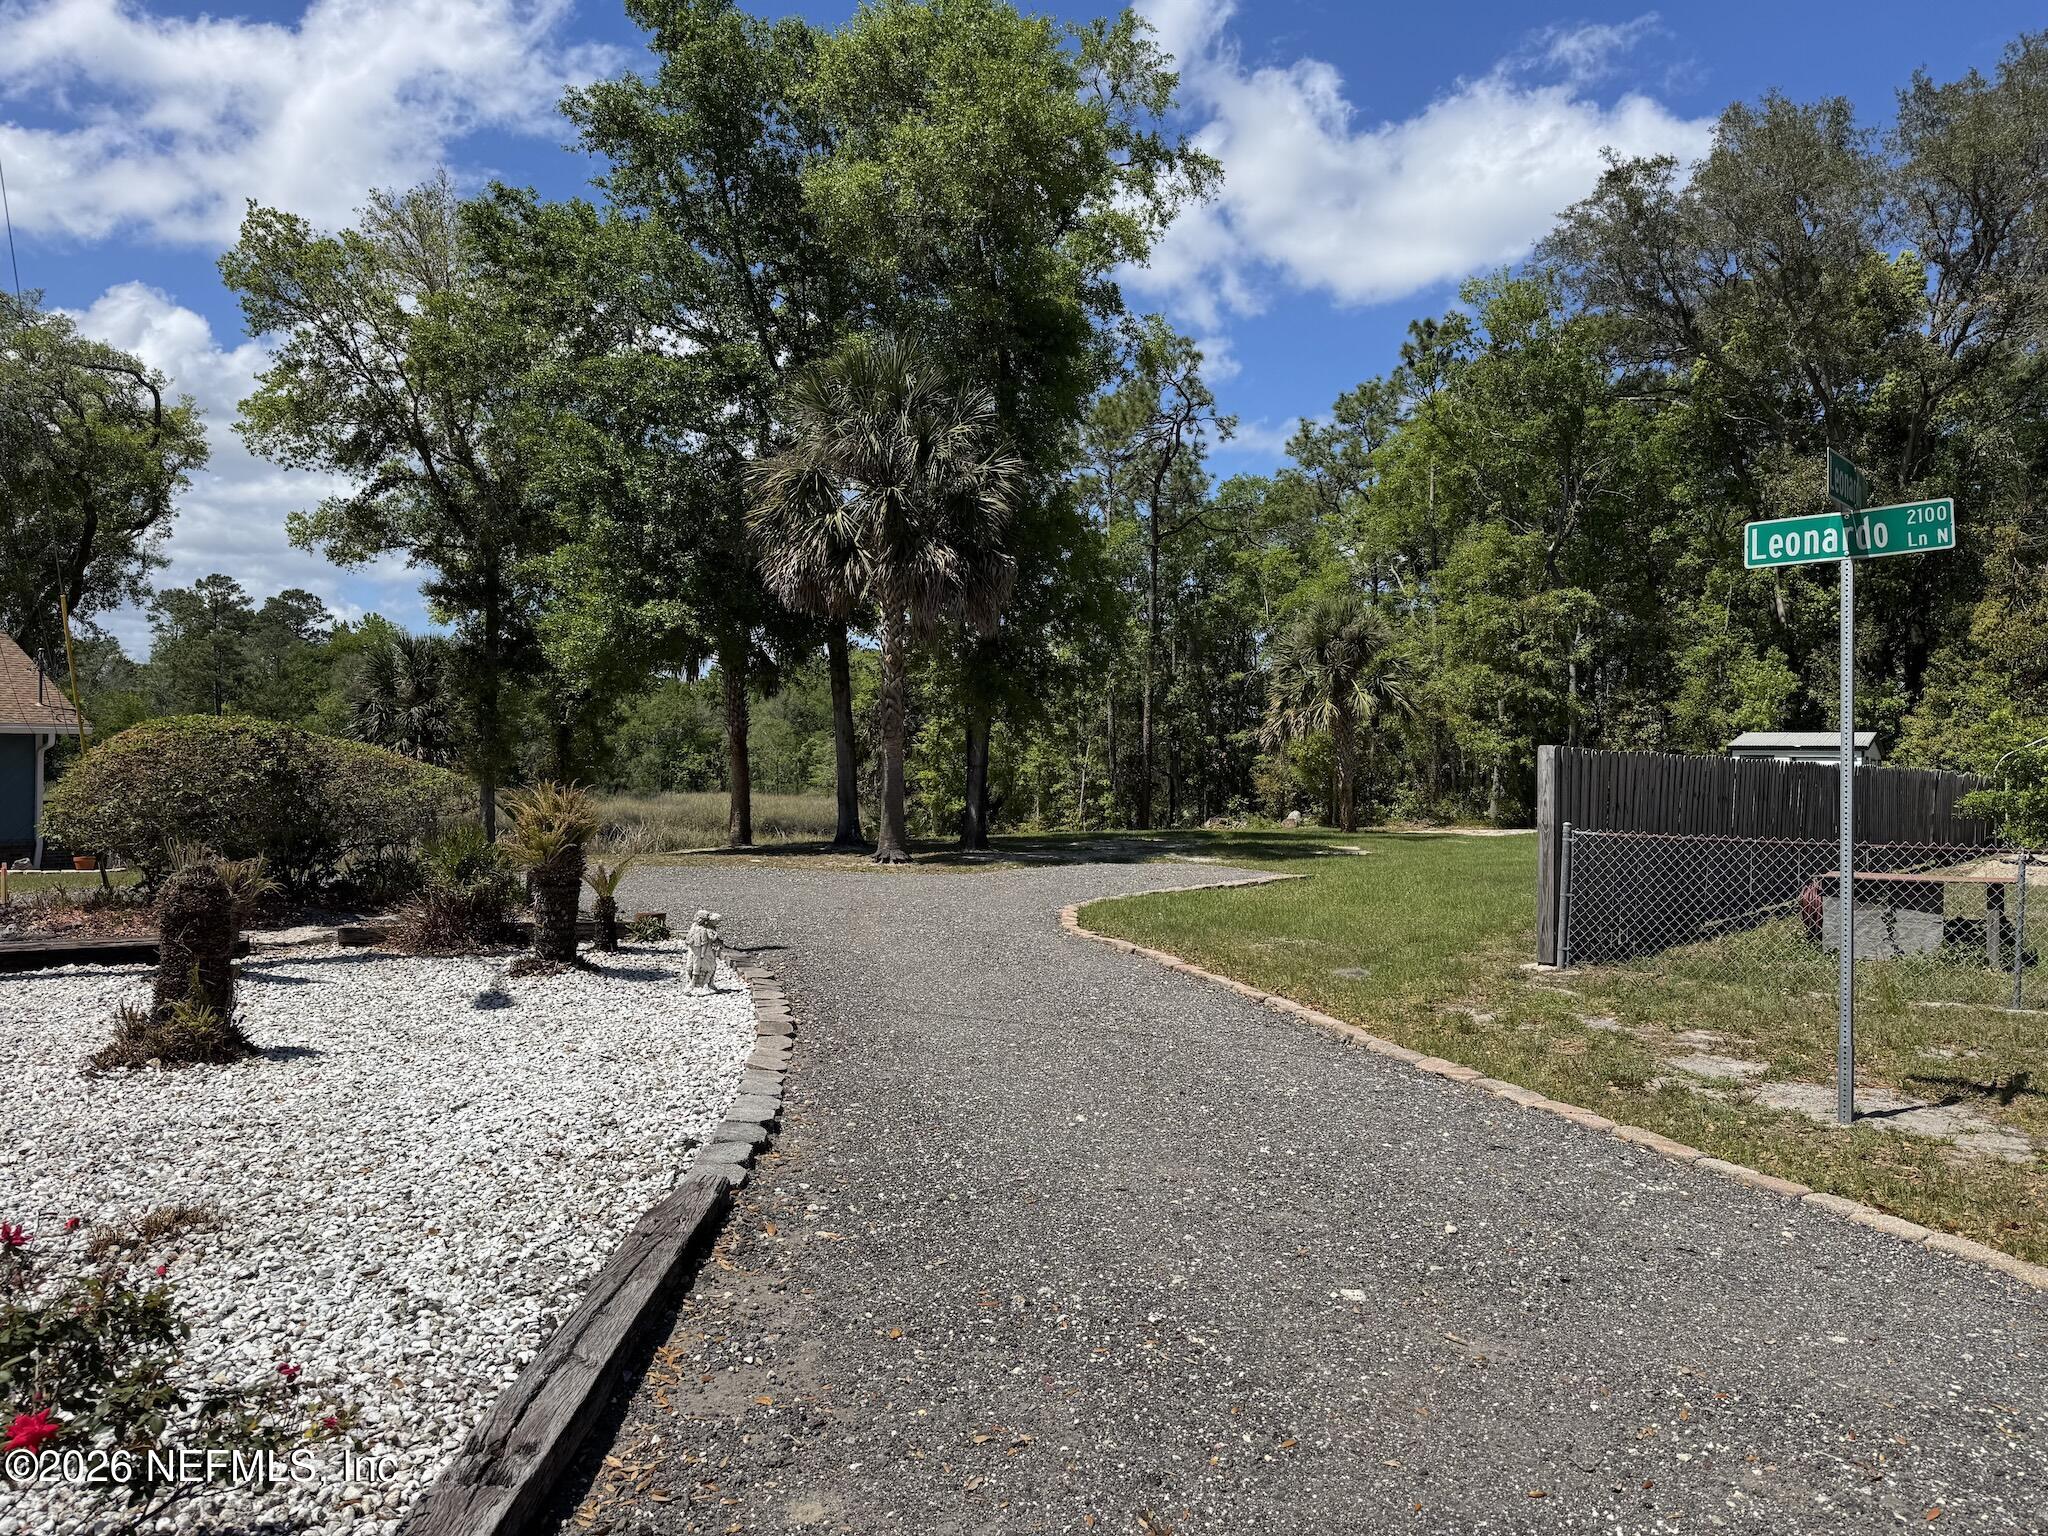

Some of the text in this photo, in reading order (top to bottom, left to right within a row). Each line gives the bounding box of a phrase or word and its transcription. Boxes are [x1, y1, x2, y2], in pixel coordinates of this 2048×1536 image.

[1907, 505, 1948, 526] 2100
[1751, 515, 1889, 561] Leonardo
[1907, 527, 1949, 548] Ln N
